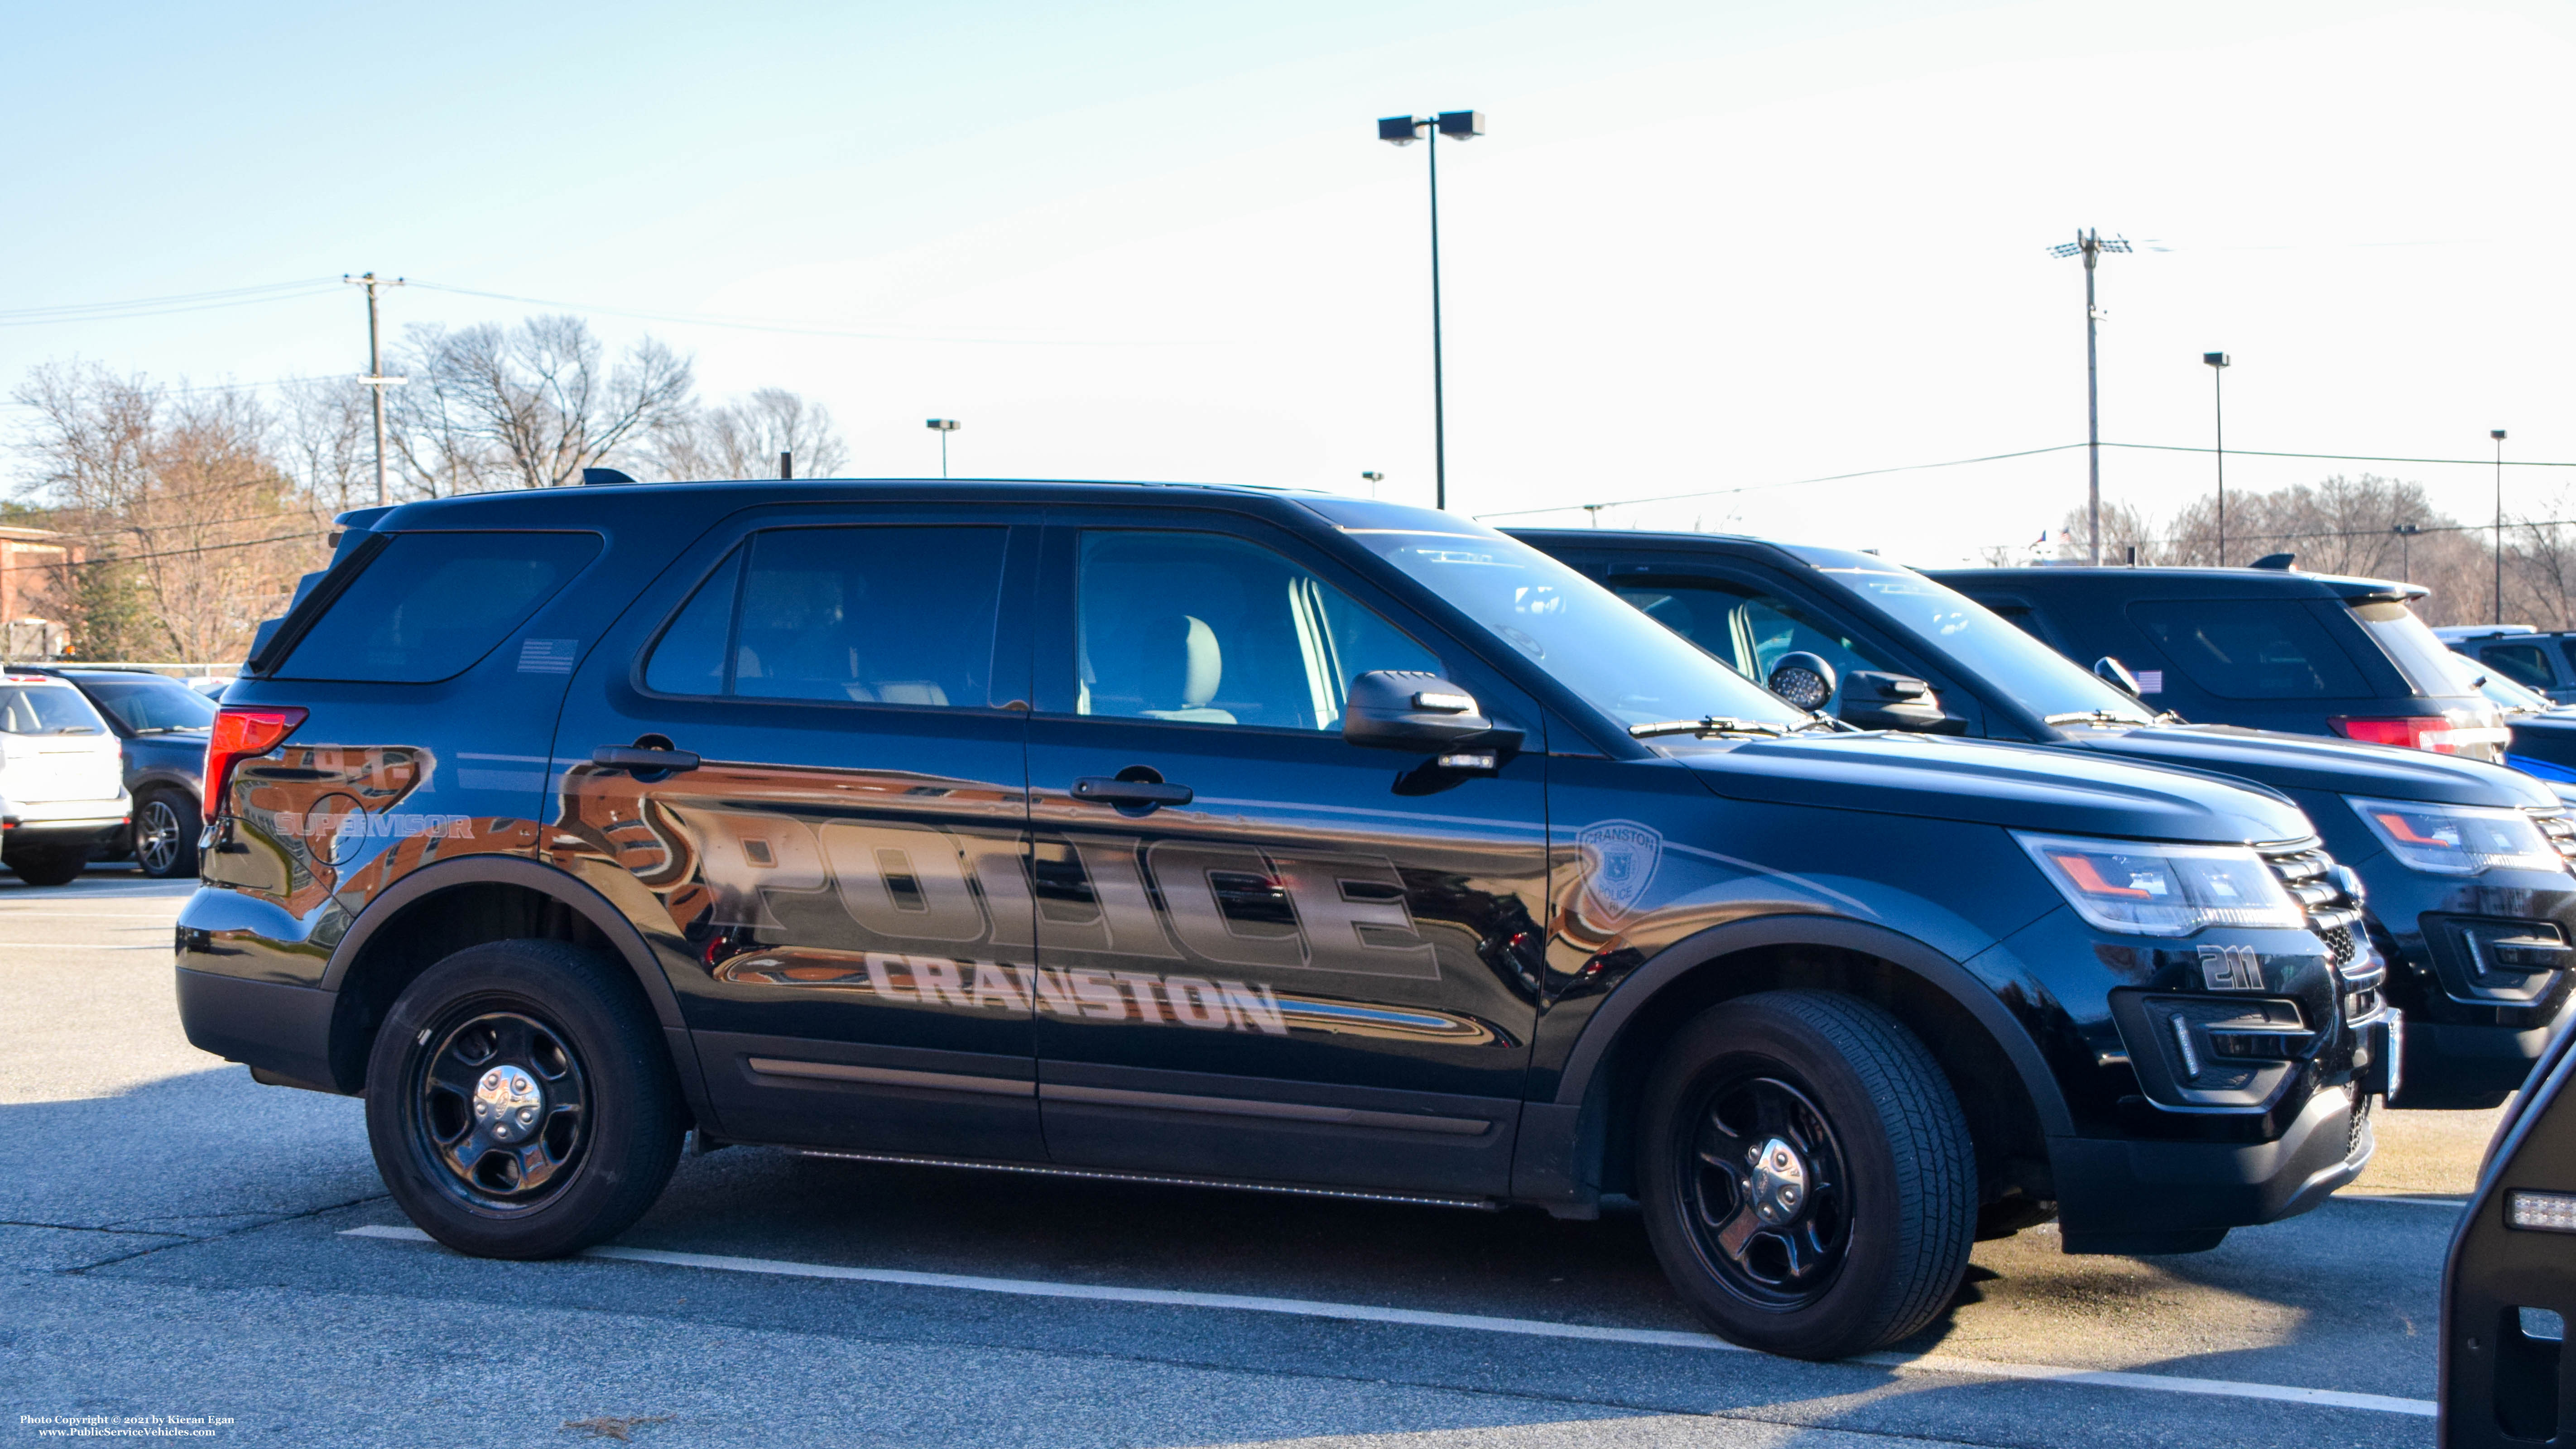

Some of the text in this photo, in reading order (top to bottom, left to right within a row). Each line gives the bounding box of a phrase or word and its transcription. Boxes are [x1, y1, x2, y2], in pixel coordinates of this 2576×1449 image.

[274, 812, 474, 839] SUPERVISOR
[1585, 828, 1654, 850] CRANSTON
[685, 809, 1441, 981] POLICE
[2196, 945, 2264, 990] 211
[864, 951, 1290, 1036] CRANSTON
